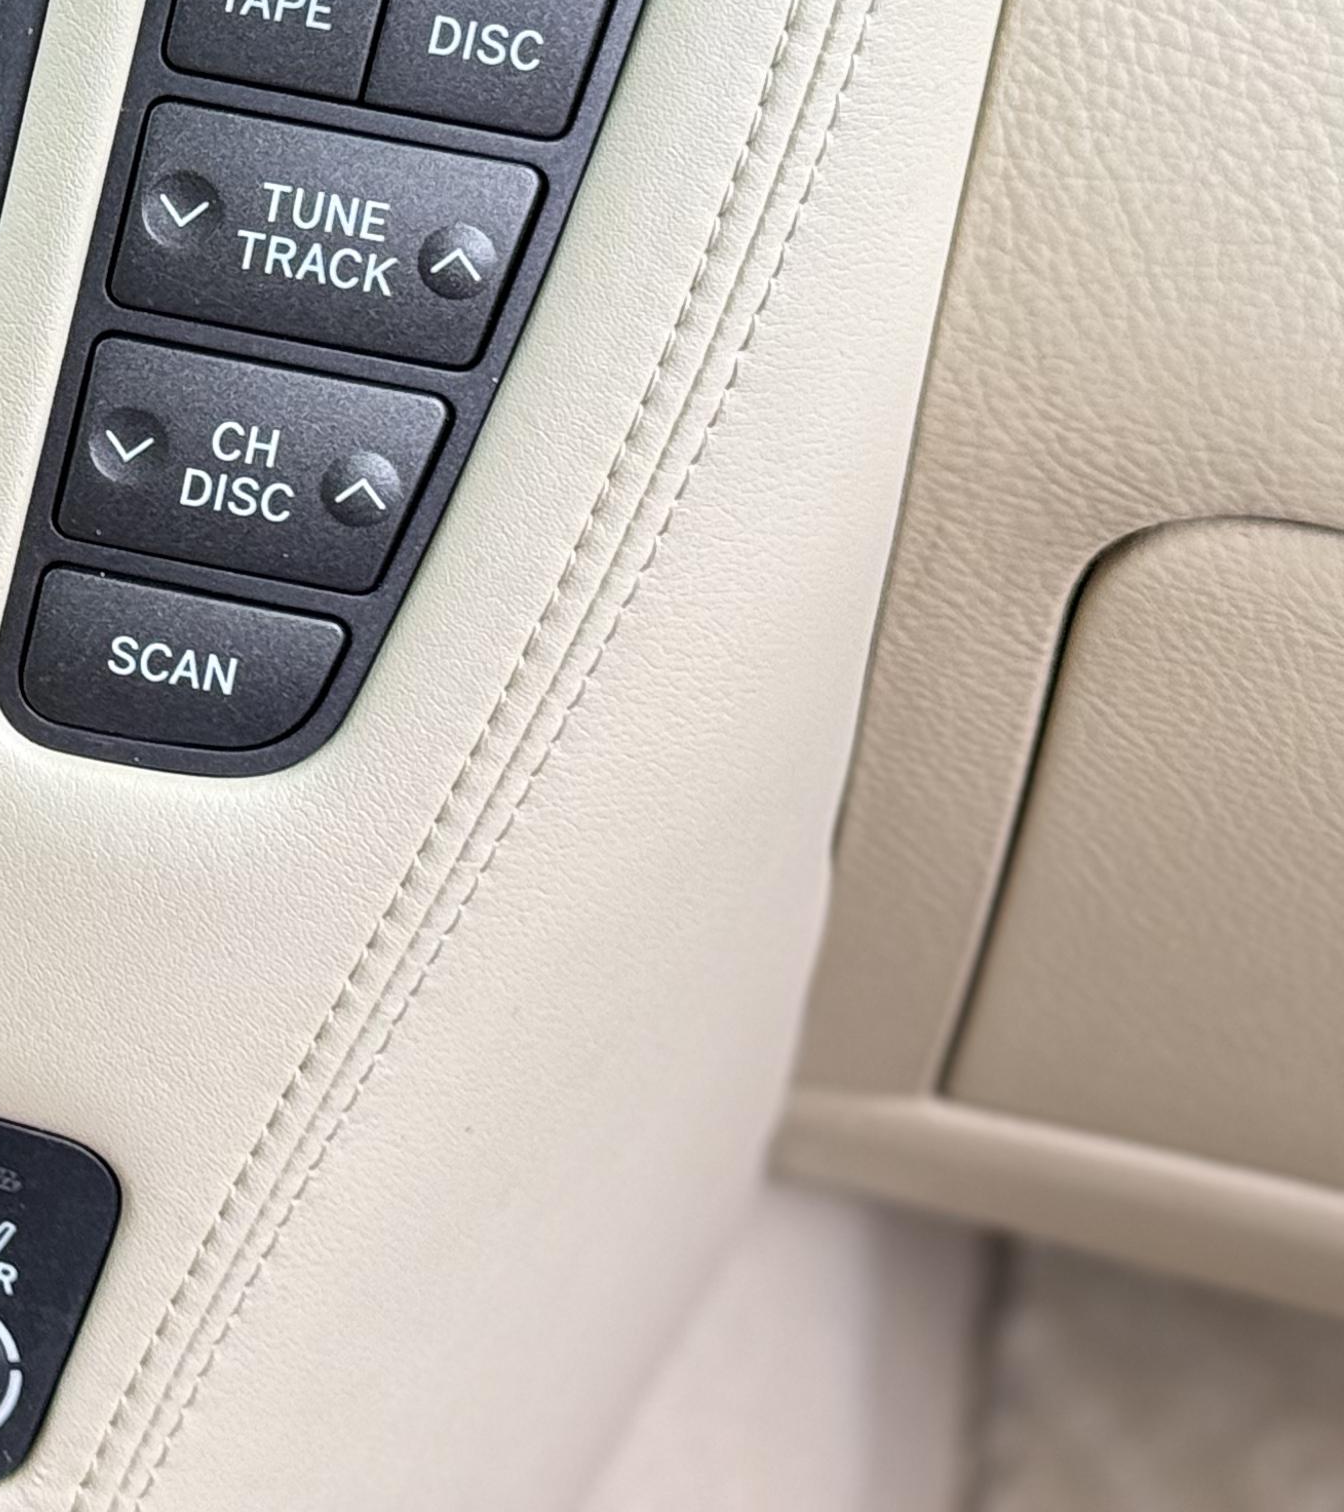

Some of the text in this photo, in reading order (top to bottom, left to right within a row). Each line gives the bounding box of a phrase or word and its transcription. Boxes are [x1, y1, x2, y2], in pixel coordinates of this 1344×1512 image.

[426, 14, 544, 72] DISC
[262, 181, 391, 243] TUNE
[236, 229, 400, 298] TRACK
[210, 420, 281, 469] CH
[179, 467, 296, 523] DISC
[106, 634, 239, 697] SCAN
